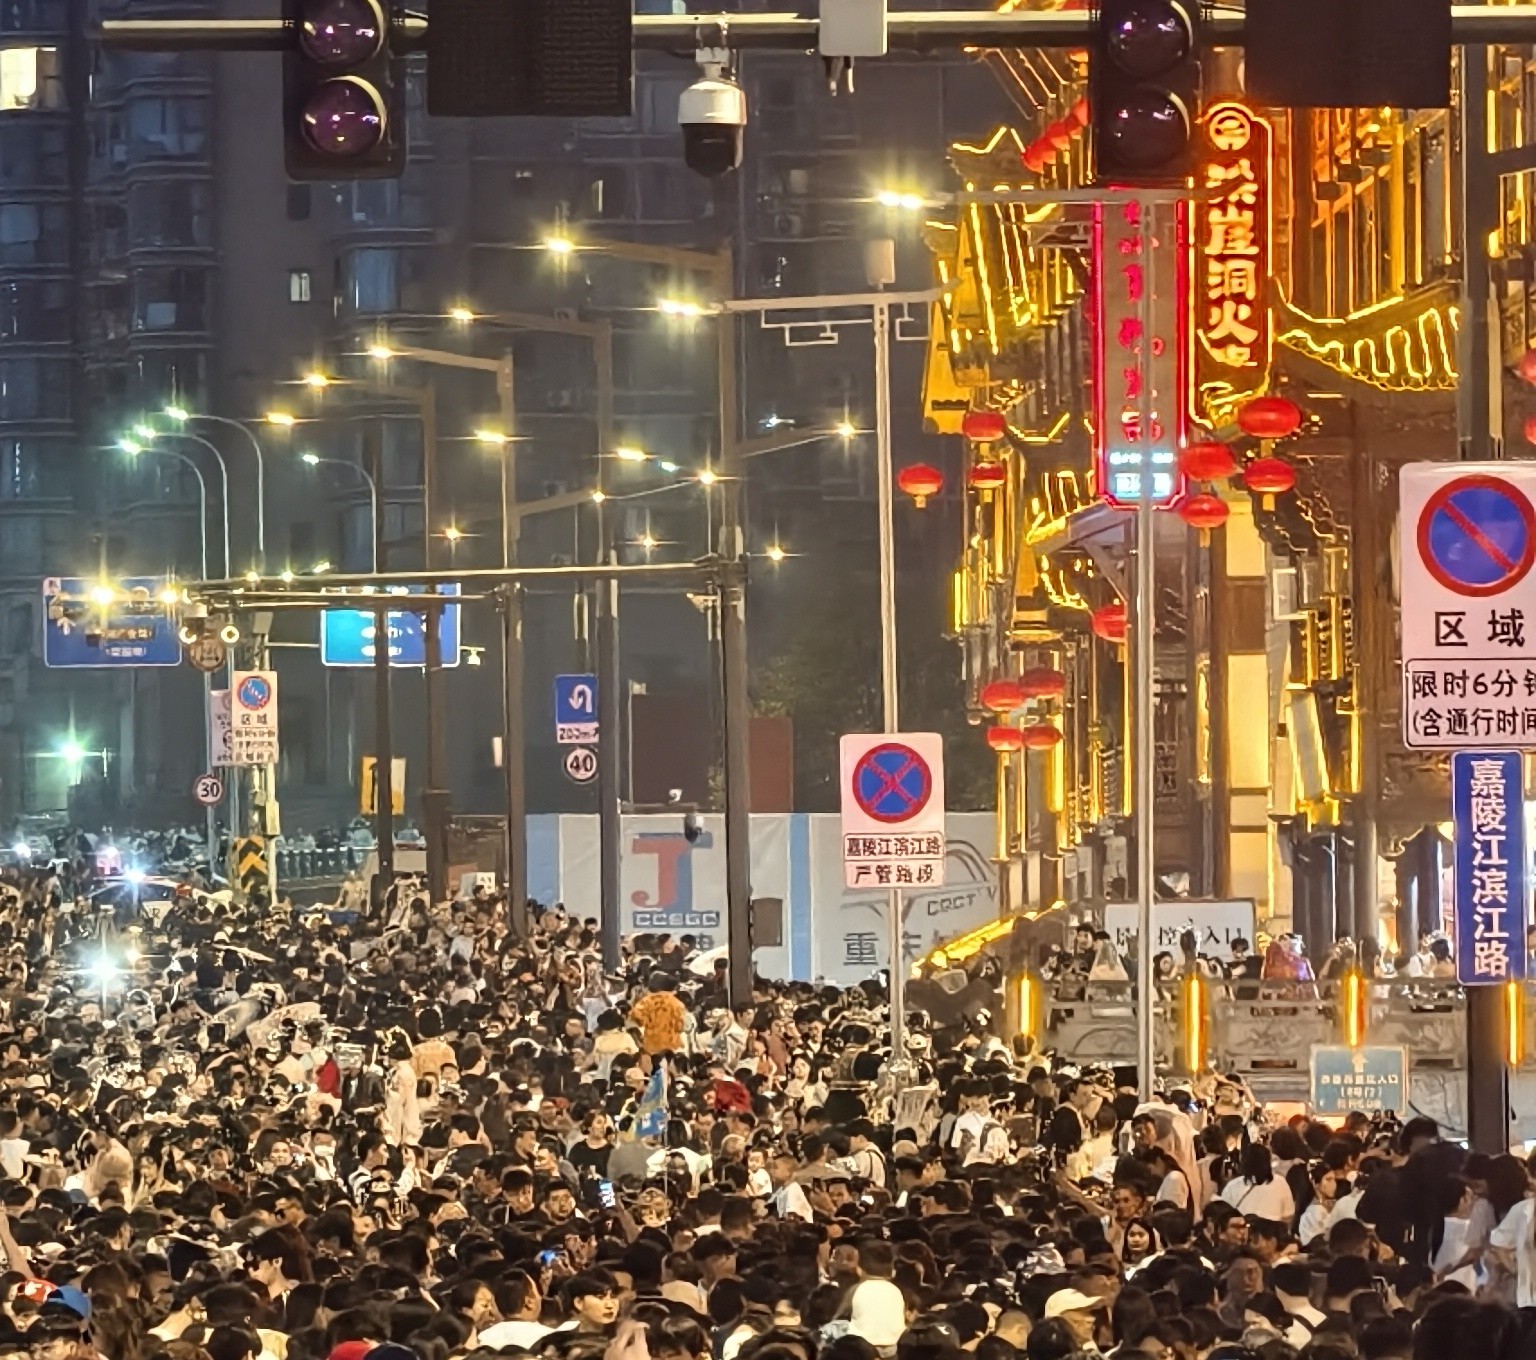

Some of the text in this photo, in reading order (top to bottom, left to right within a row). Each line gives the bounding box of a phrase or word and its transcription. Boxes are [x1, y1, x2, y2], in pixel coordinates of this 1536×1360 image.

[1435, 608, 1525, 647] 区域
[570, 754, 594, 773] 40
[201, 782, 221, 798] 30
[1470, 758, 1510, 977] 嘉陵江滨江路
